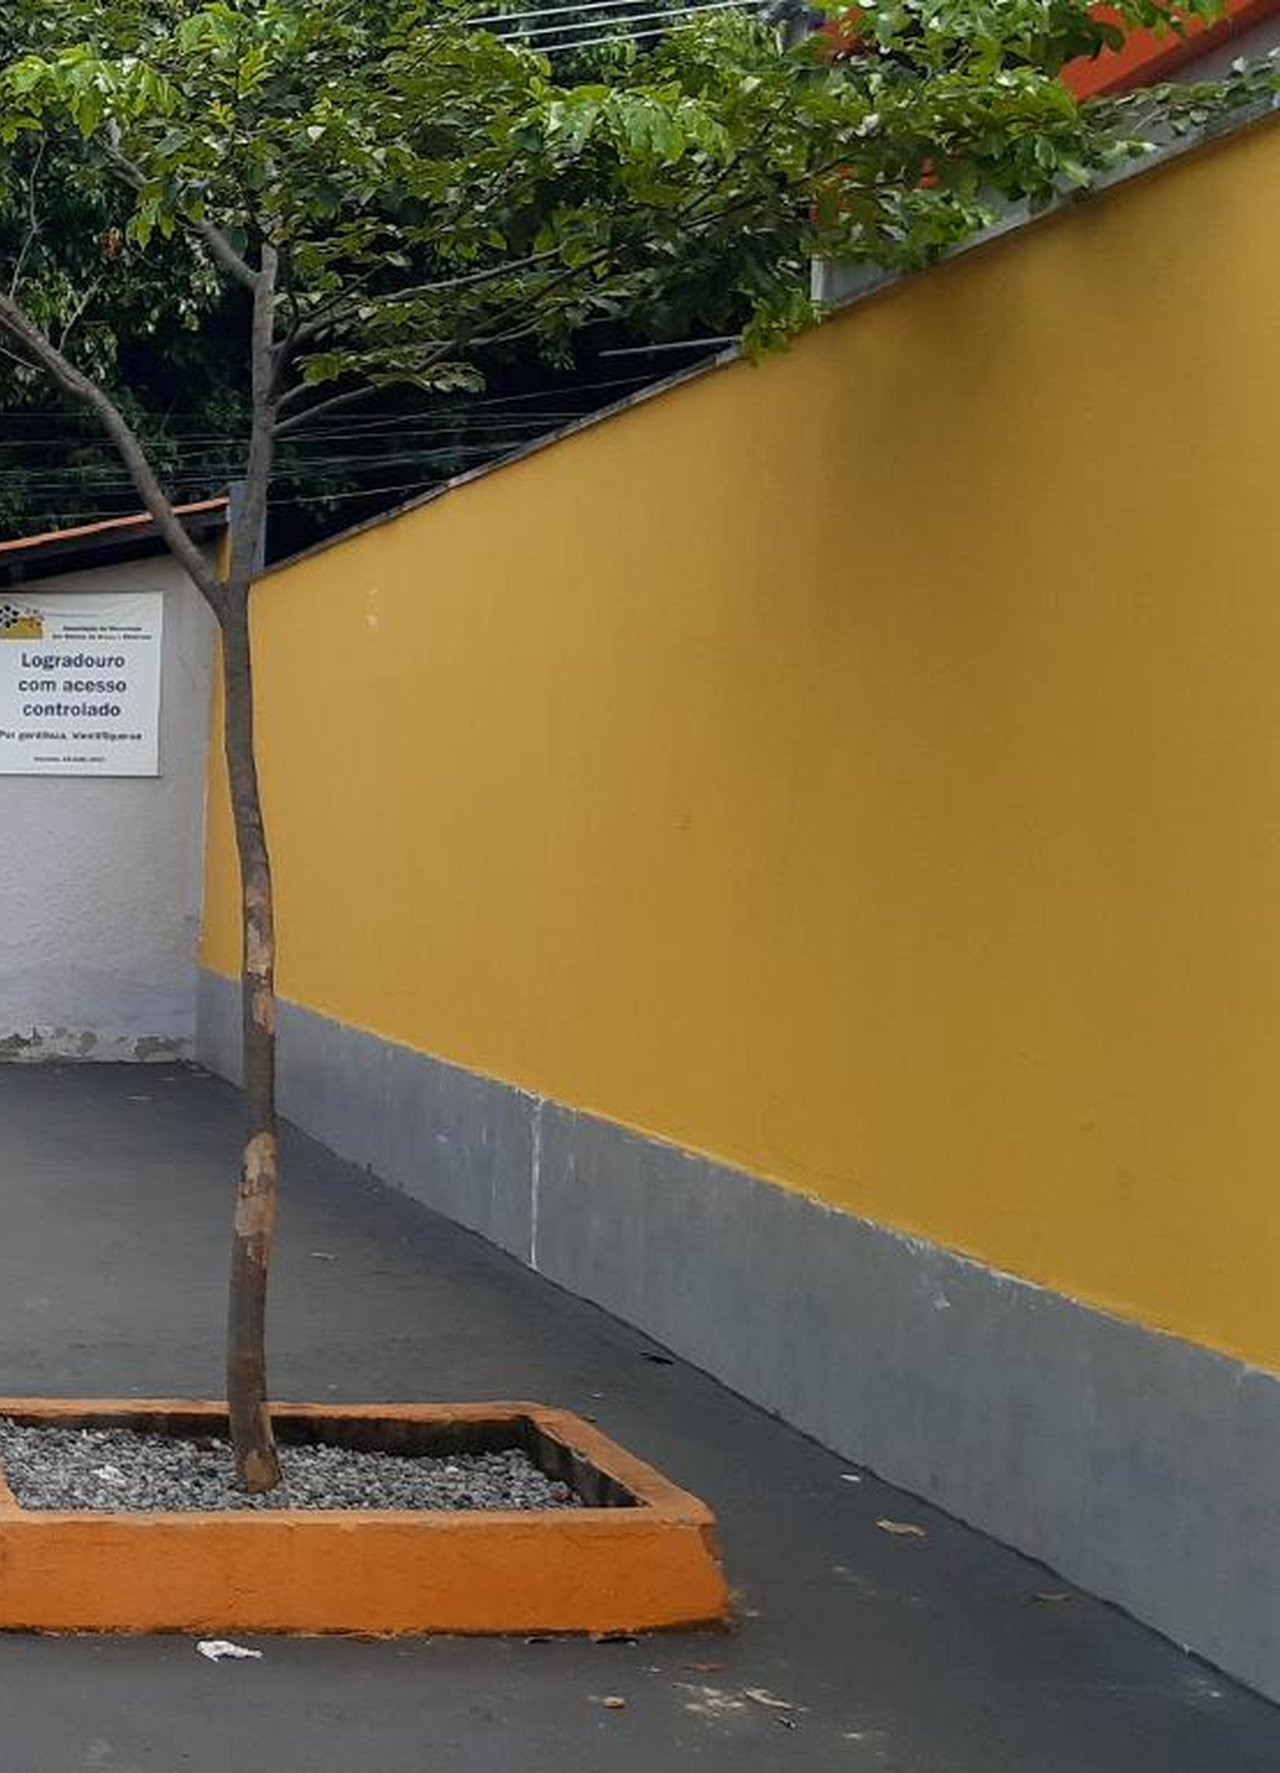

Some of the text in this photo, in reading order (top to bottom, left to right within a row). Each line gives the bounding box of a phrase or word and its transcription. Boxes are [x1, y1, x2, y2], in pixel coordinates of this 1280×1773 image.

[21, 653, 125, 671] Logradouro
[18, 680, 127, 693] com acesso
[22, 702, 121, 717] controlado
